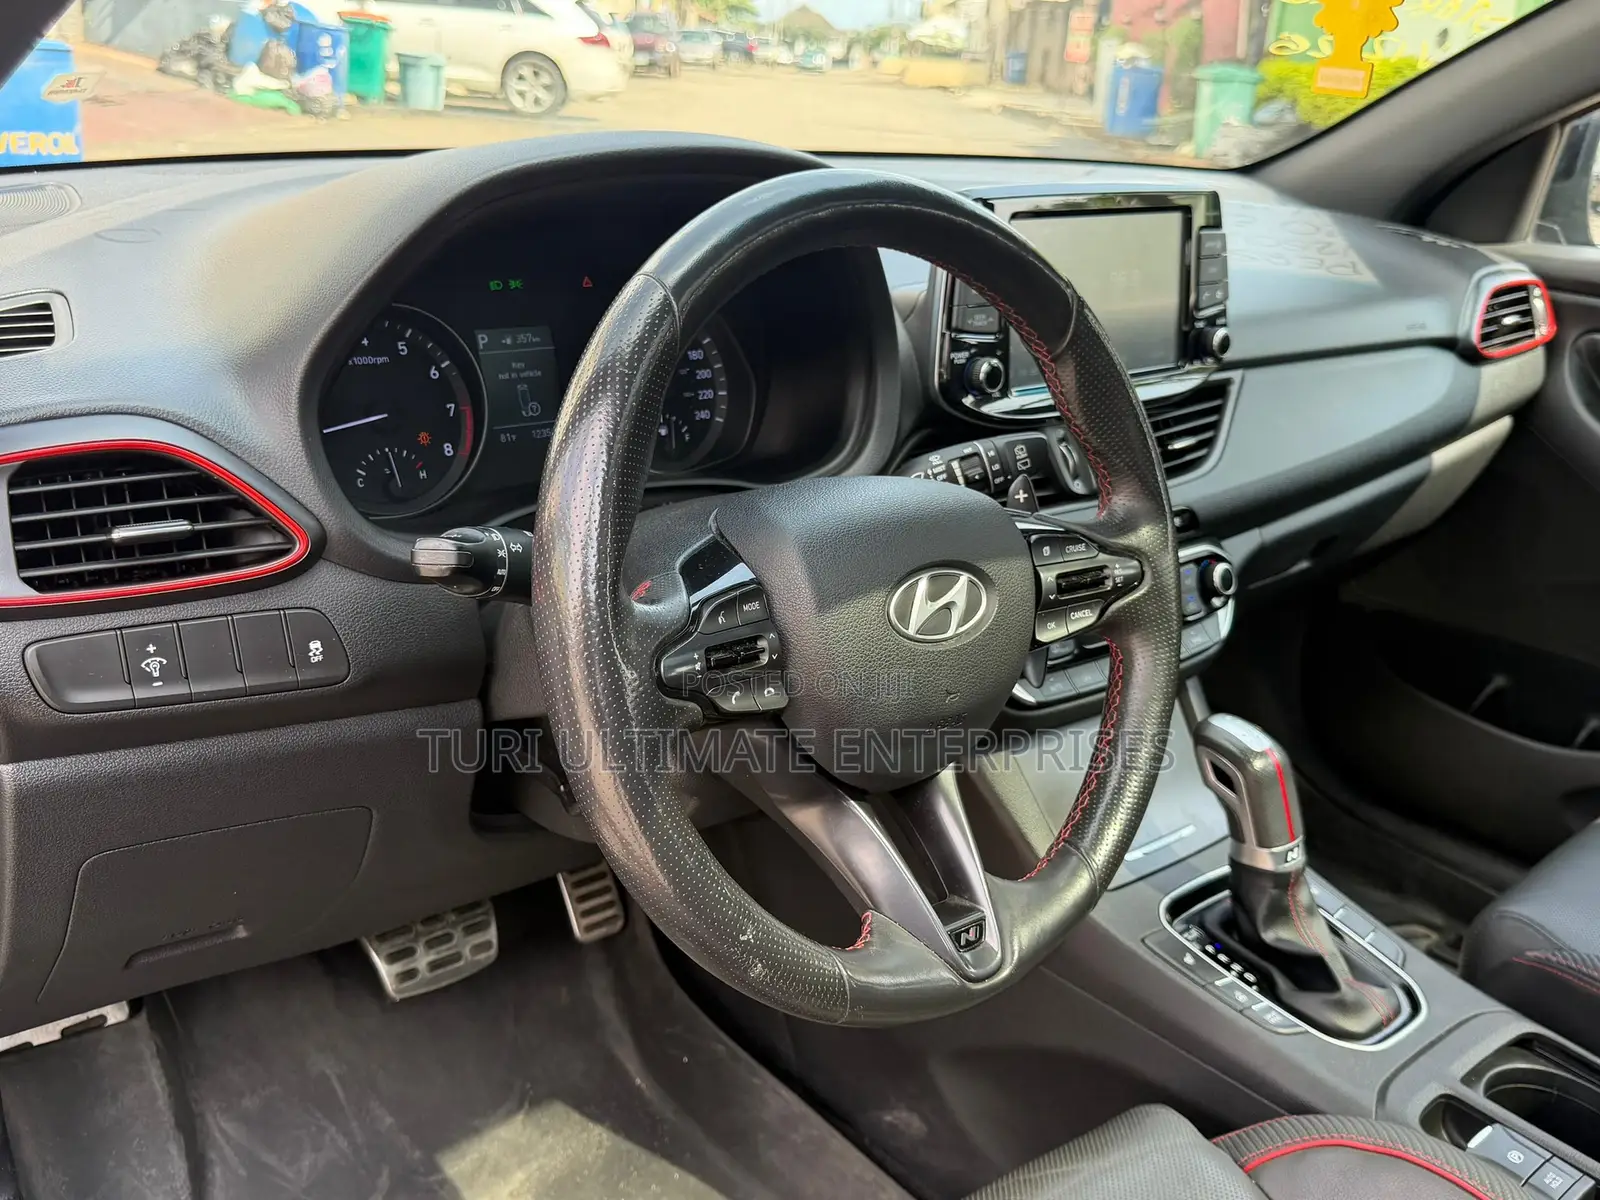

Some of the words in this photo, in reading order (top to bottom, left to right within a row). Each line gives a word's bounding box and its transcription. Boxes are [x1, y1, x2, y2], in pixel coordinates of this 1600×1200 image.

[478, 334, 488, 349] P
[397, 341, 408, 355] 5
[687, 349, 704, 360] 180
[950, 351, 969, 360] POWER
[430, 366, 440, 379] 6
[695, 369, 712, 380] 200
[697, 389, 714, 400] 220
[446, 403, 455, 417] 7
[694, 410, 711, 420] 240
[684, 433, 691, 442] F
[443, 442, 454, 456] 8
[932, 465, 946, 474] MIST
[991, 463, 1001, 471] LO
[419, 470, 427, 480] H
[936, 473, 948, 482] OFF
[357, 478, 365, 488] C
[993, 476, 1005, 485] OFF
[1065, 543, 1087, 553] CRUISE
[743, 601, 760, 612] MODE
[1070, 609, 1093, 620] CANCEL
[1046, 621, 1056, 630] OK
[310, 654, 324, 664] OFF
[960, 925, 980, 946] N
